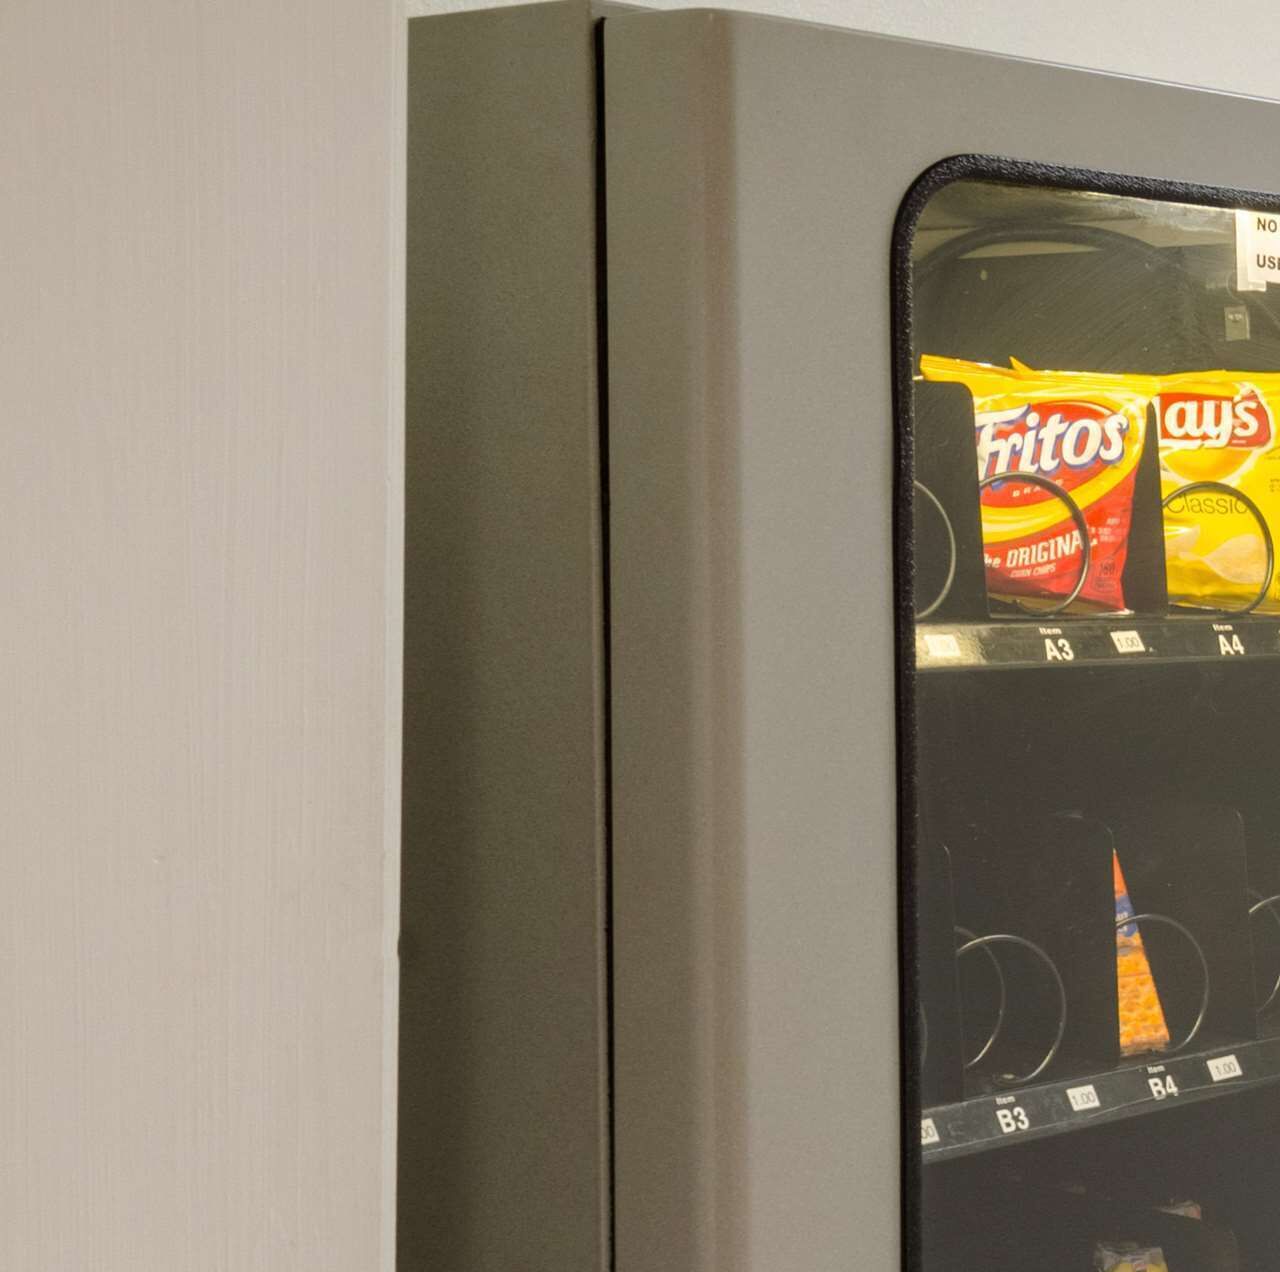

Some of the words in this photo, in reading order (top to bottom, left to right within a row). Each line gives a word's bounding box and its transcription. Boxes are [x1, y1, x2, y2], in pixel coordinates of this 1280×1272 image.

[1257, 217, 1277, 233] NO
[976, 403, 1128, 487] Fritos
[1167, 494, 1251, 515] Classic
[1032, 562, 1057, 576] CHIPS
[1039, 627, 1062, 635] Item
[1044, 638, 1074, 661] A3
[1116, 636, 1139, 649] 1.00
[1218, 634, 1245, 656] A4
[1214, 1062, 1237, 1076] 1.00
[1148, 1075, 1178, 1100] B4
[1071, 1090, 1096, 1106] 1.00
[995, 1106, 1030, 1134] B3
